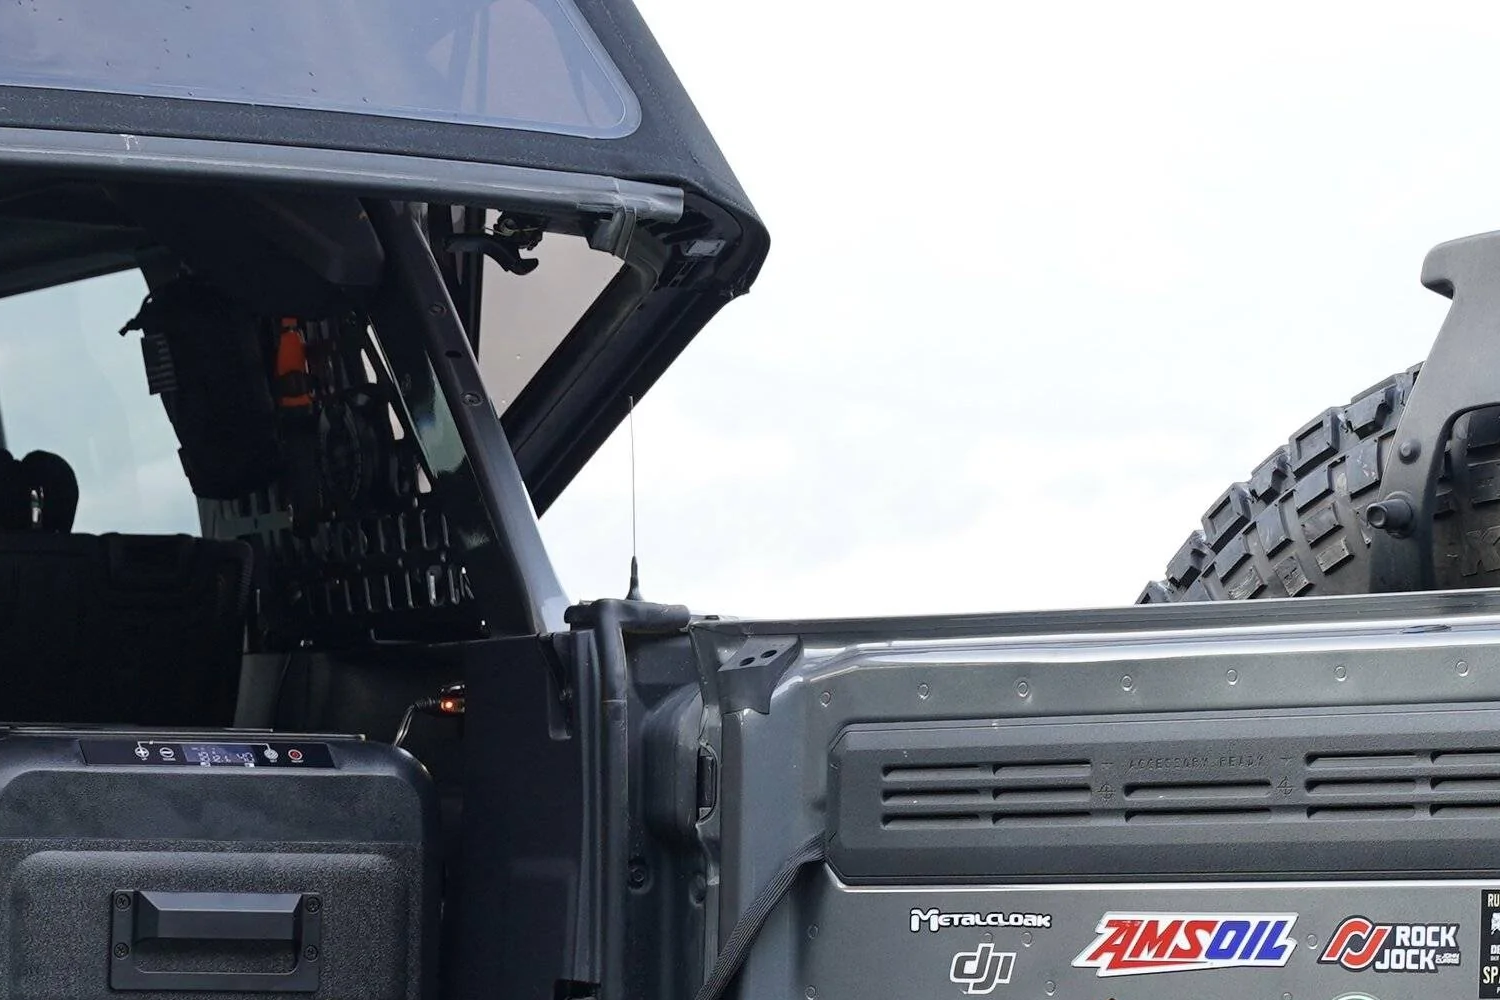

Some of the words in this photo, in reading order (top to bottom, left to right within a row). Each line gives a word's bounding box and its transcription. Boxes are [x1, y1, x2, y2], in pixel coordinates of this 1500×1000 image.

[1085, 920, 1289, 970] AMSOIL
[1396, 926, 1456, 947] ROCK
[1375, 949, 1436, 970] JOCK
